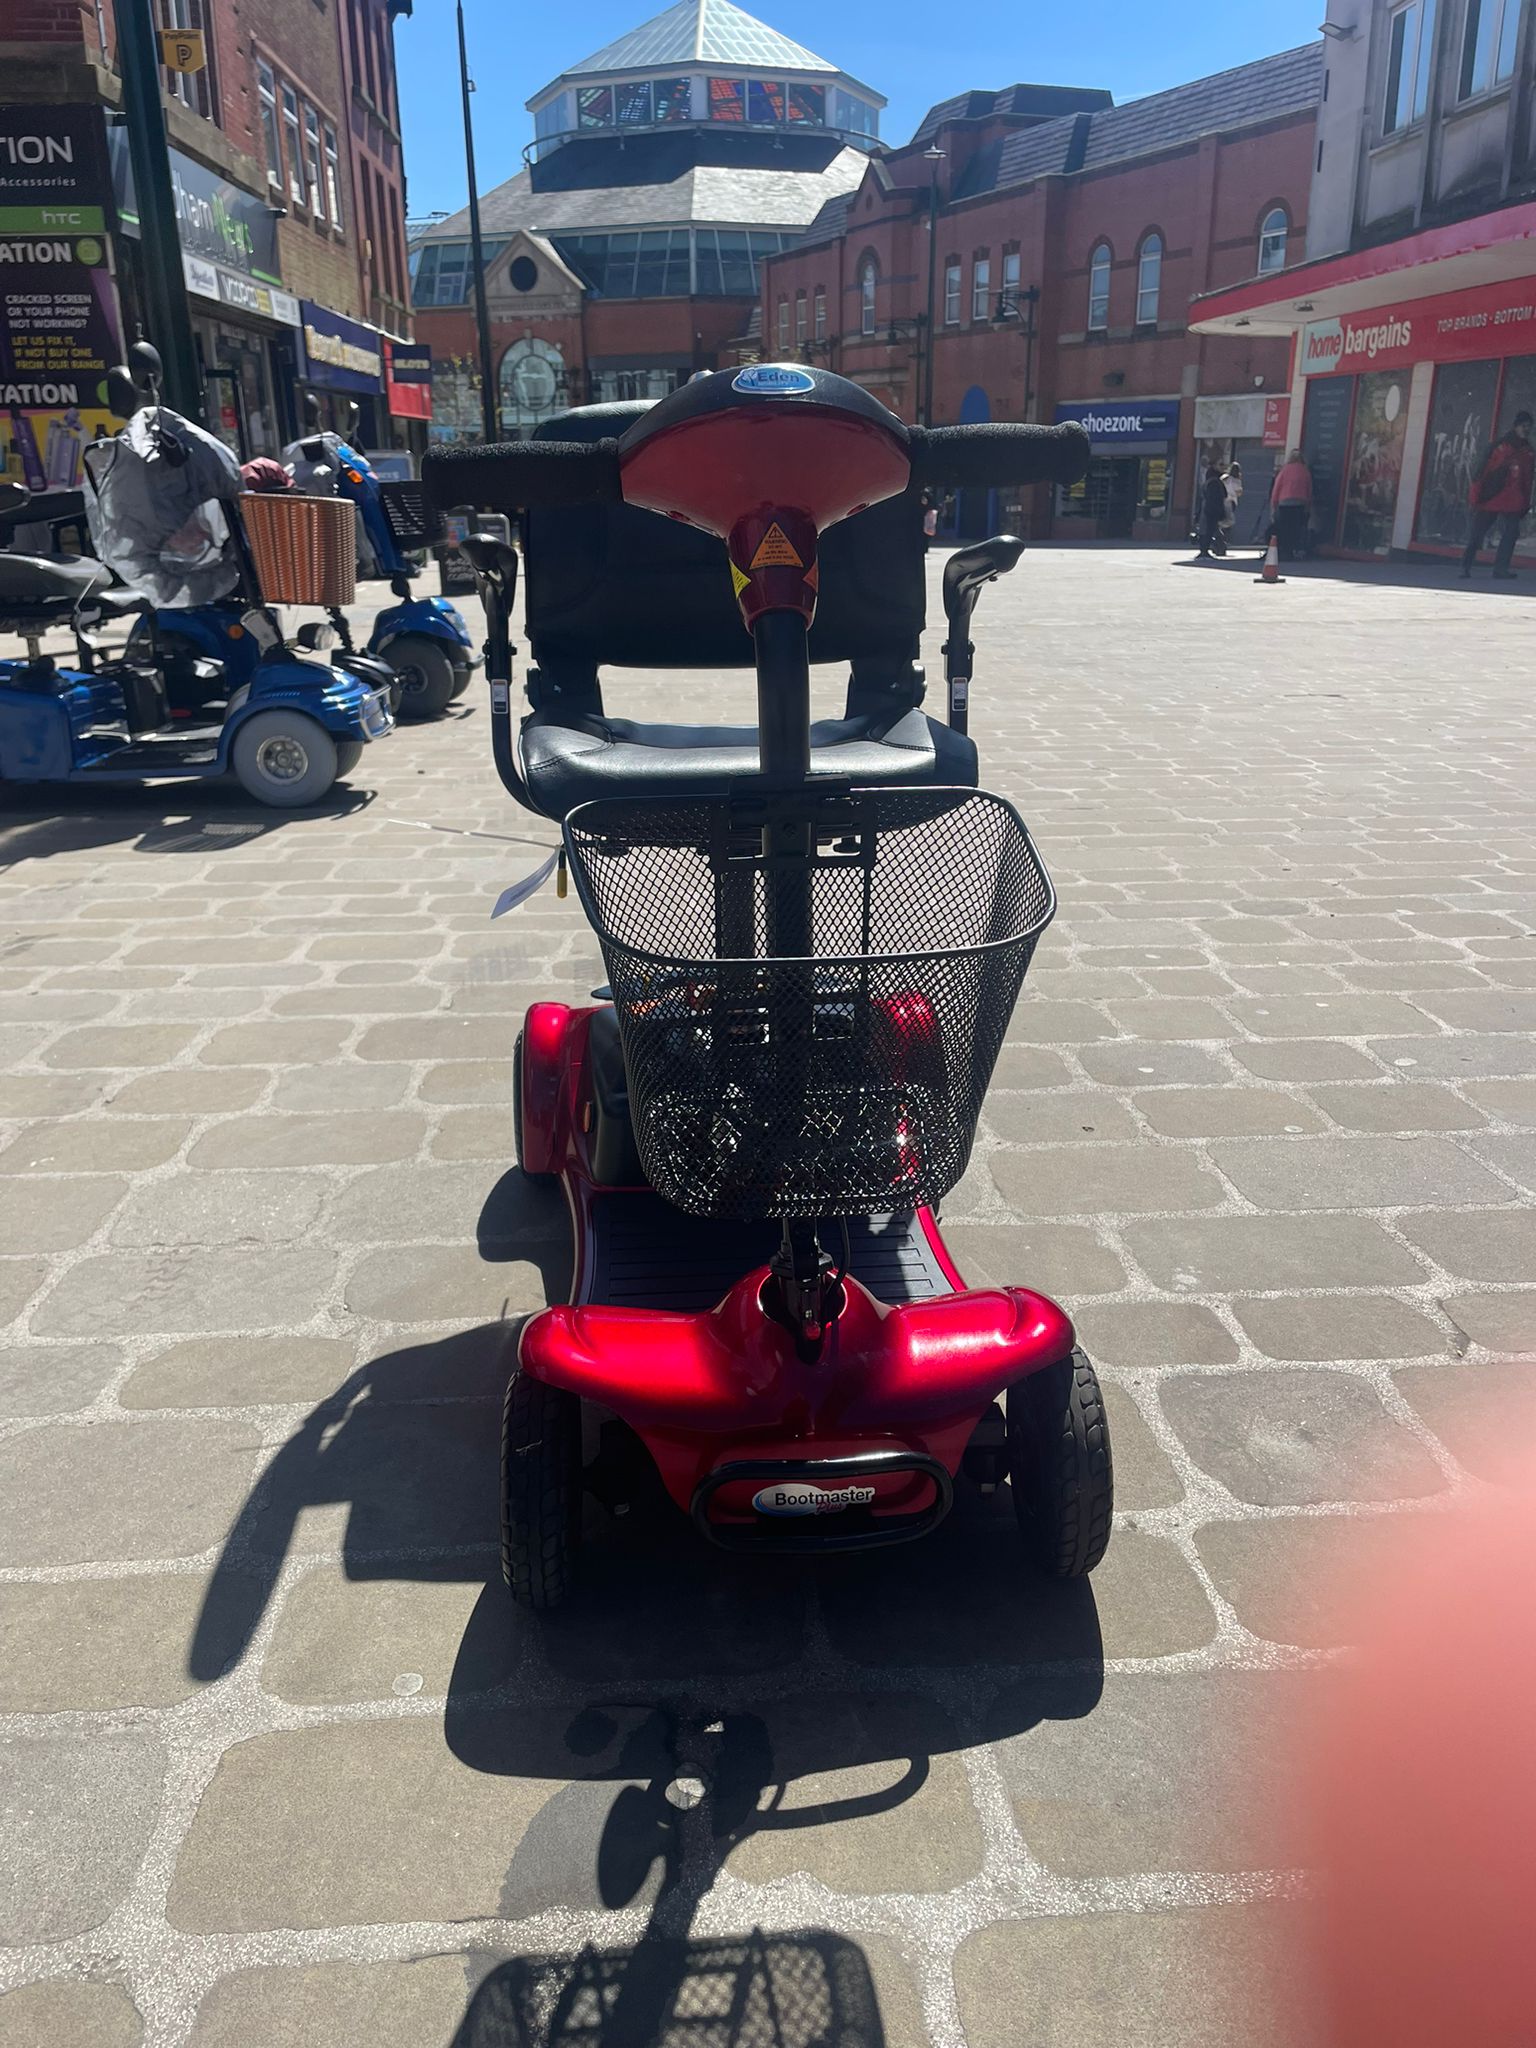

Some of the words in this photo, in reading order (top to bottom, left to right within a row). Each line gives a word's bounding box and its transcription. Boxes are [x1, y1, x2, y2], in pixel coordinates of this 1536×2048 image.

[0, 176, 77, 187] Accessories
[5, 294, 52, 305] CRACKED
[53, 294, 92, 304] SCREEN
[7, 306, 23, 317] OR
[24, 306, 53, 317] YOUR
[54, 306, 91, 317] PHONE
[9, 319, 31, 329] NOT
[33, 319, 88, 329] WORKING?
[1437, 319, 1454, 334] TOP
[1454, 312, 1489, 331] BRANDS
[1494, 305, 1533, 326] BOTTOM
[12, 336, 28, 346] LET
[31, 336, 45, 346] US
[1307, 331, 1342, 360] home
[1345, 315, 1412, 359] bargains
[25, 348, 46, 358] NOT
[48, 348, 69, 358] BUY
[71, 348, 94, 358] ONE
[16, 360, 45, 370] FROM
[47, 360, 69, 370] OUR
[71, 360, 106, 370] RANGE
[757, 371, 800, 383] Eden
[1081, 411, 1144, 433] shoezone
[775, 1489, 874, 1506] Bootmaster
